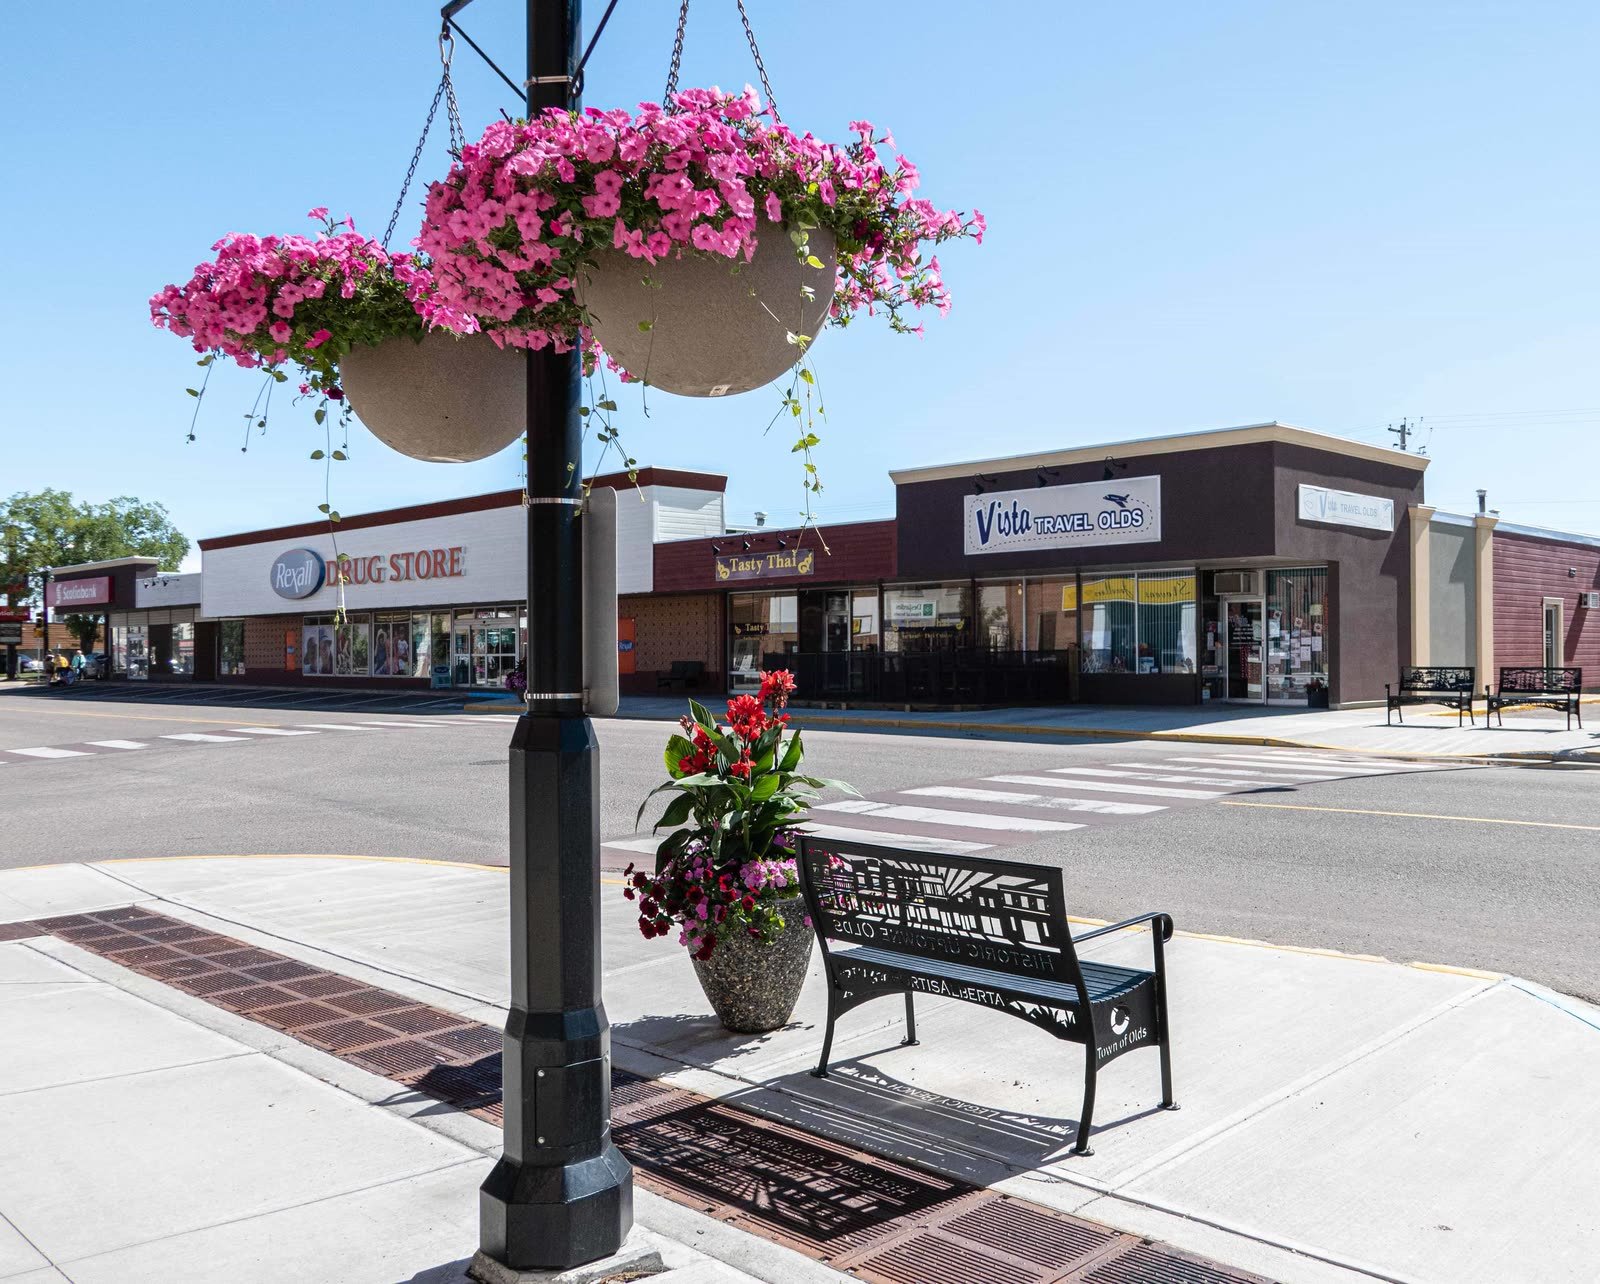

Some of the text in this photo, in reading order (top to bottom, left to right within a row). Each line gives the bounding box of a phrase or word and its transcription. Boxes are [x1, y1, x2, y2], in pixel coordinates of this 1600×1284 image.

[976, 499, 1144, 546] Vista TRAVEL OLDS
[1341, 503, 1362, 516] TRAVEL
[1362, 507, 1378, 517] OLDS
[276, 559, 313, 593] Rexall
[325, 546, 465, 587] DRUG STORE
[729, 552, 797, 575] Tasty Thai
[63, 584, 97, 600] Scotiabank
[745, 623, 764, 633] Tasty
[1096, 1026, 1148, 1060] Town of Olds
